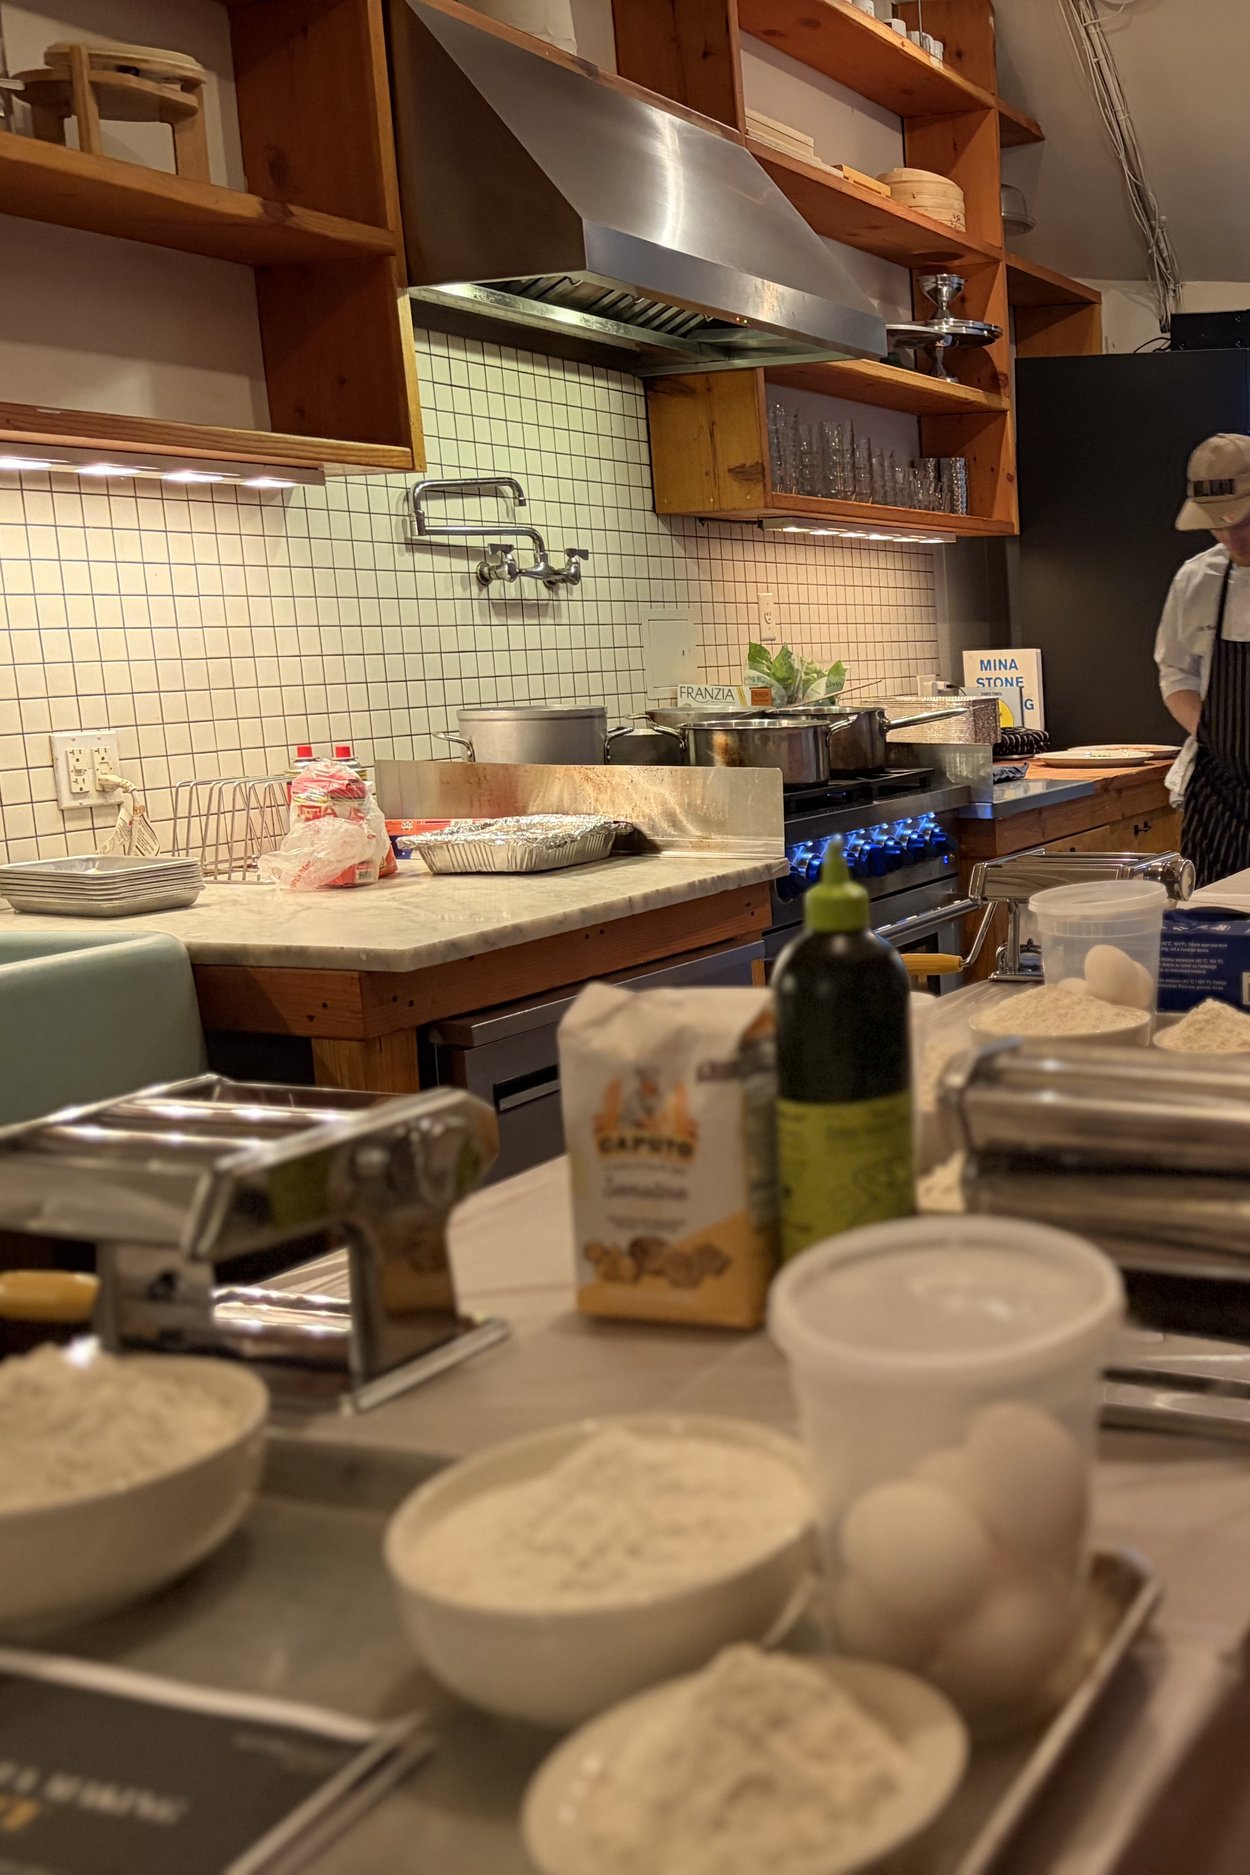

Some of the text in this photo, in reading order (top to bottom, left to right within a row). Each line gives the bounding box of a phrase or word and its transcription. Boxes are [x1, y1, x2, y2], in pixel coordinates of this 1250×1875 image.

[980, 659, 1018, 671] MINA
[825, 680, 843, 688] Livin
[976, 677, 1023, 688] STONE
[679, 686, 735, 704] FRANZIA
[599, 1136, 693, 1158] CAPUTO
